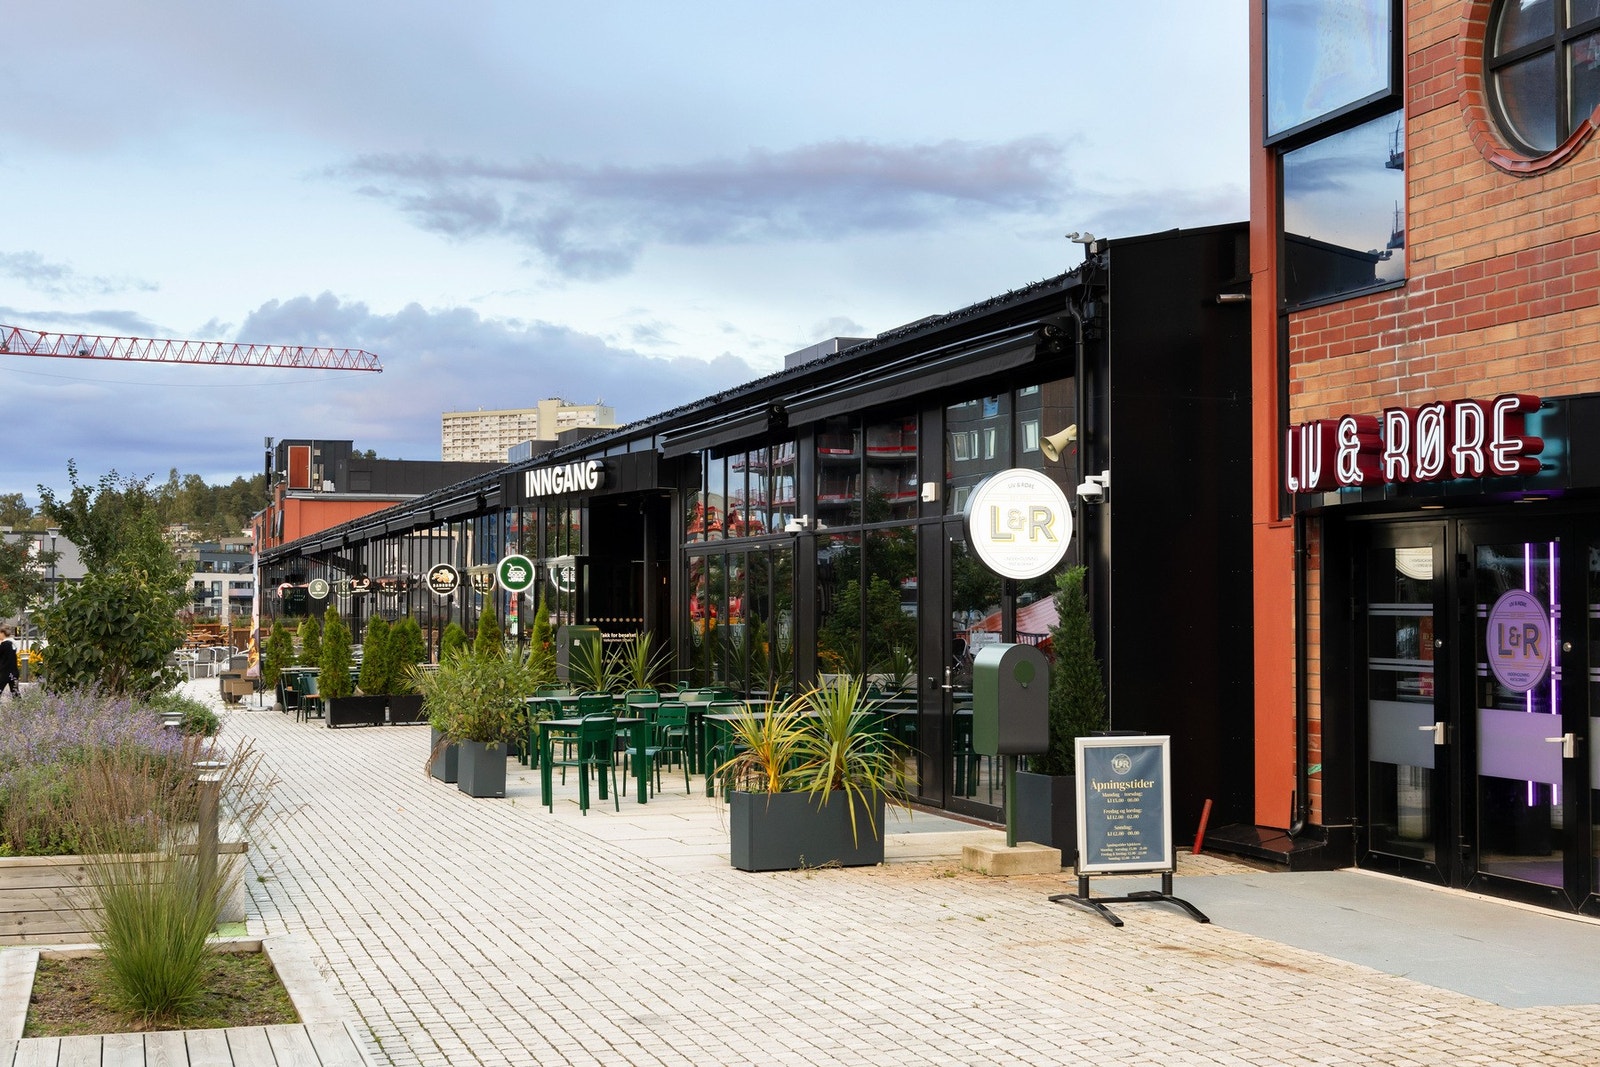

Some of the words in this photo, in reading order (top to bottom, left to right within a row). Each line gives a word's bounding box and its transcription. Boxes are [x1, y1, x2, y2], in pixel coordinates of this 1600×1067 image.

[1286, 421, 1324, 492] LIV
[1336, 415, 1364, 486] &
[1383, 396, 1524, 481] RØRE
[525, 460, 599, 498] INNGANG
[990, 505, 1059, 542] L&R
[1497, 622, 1544, 660] L&R
[1091, 778, 1154, 791] Åpningstider
